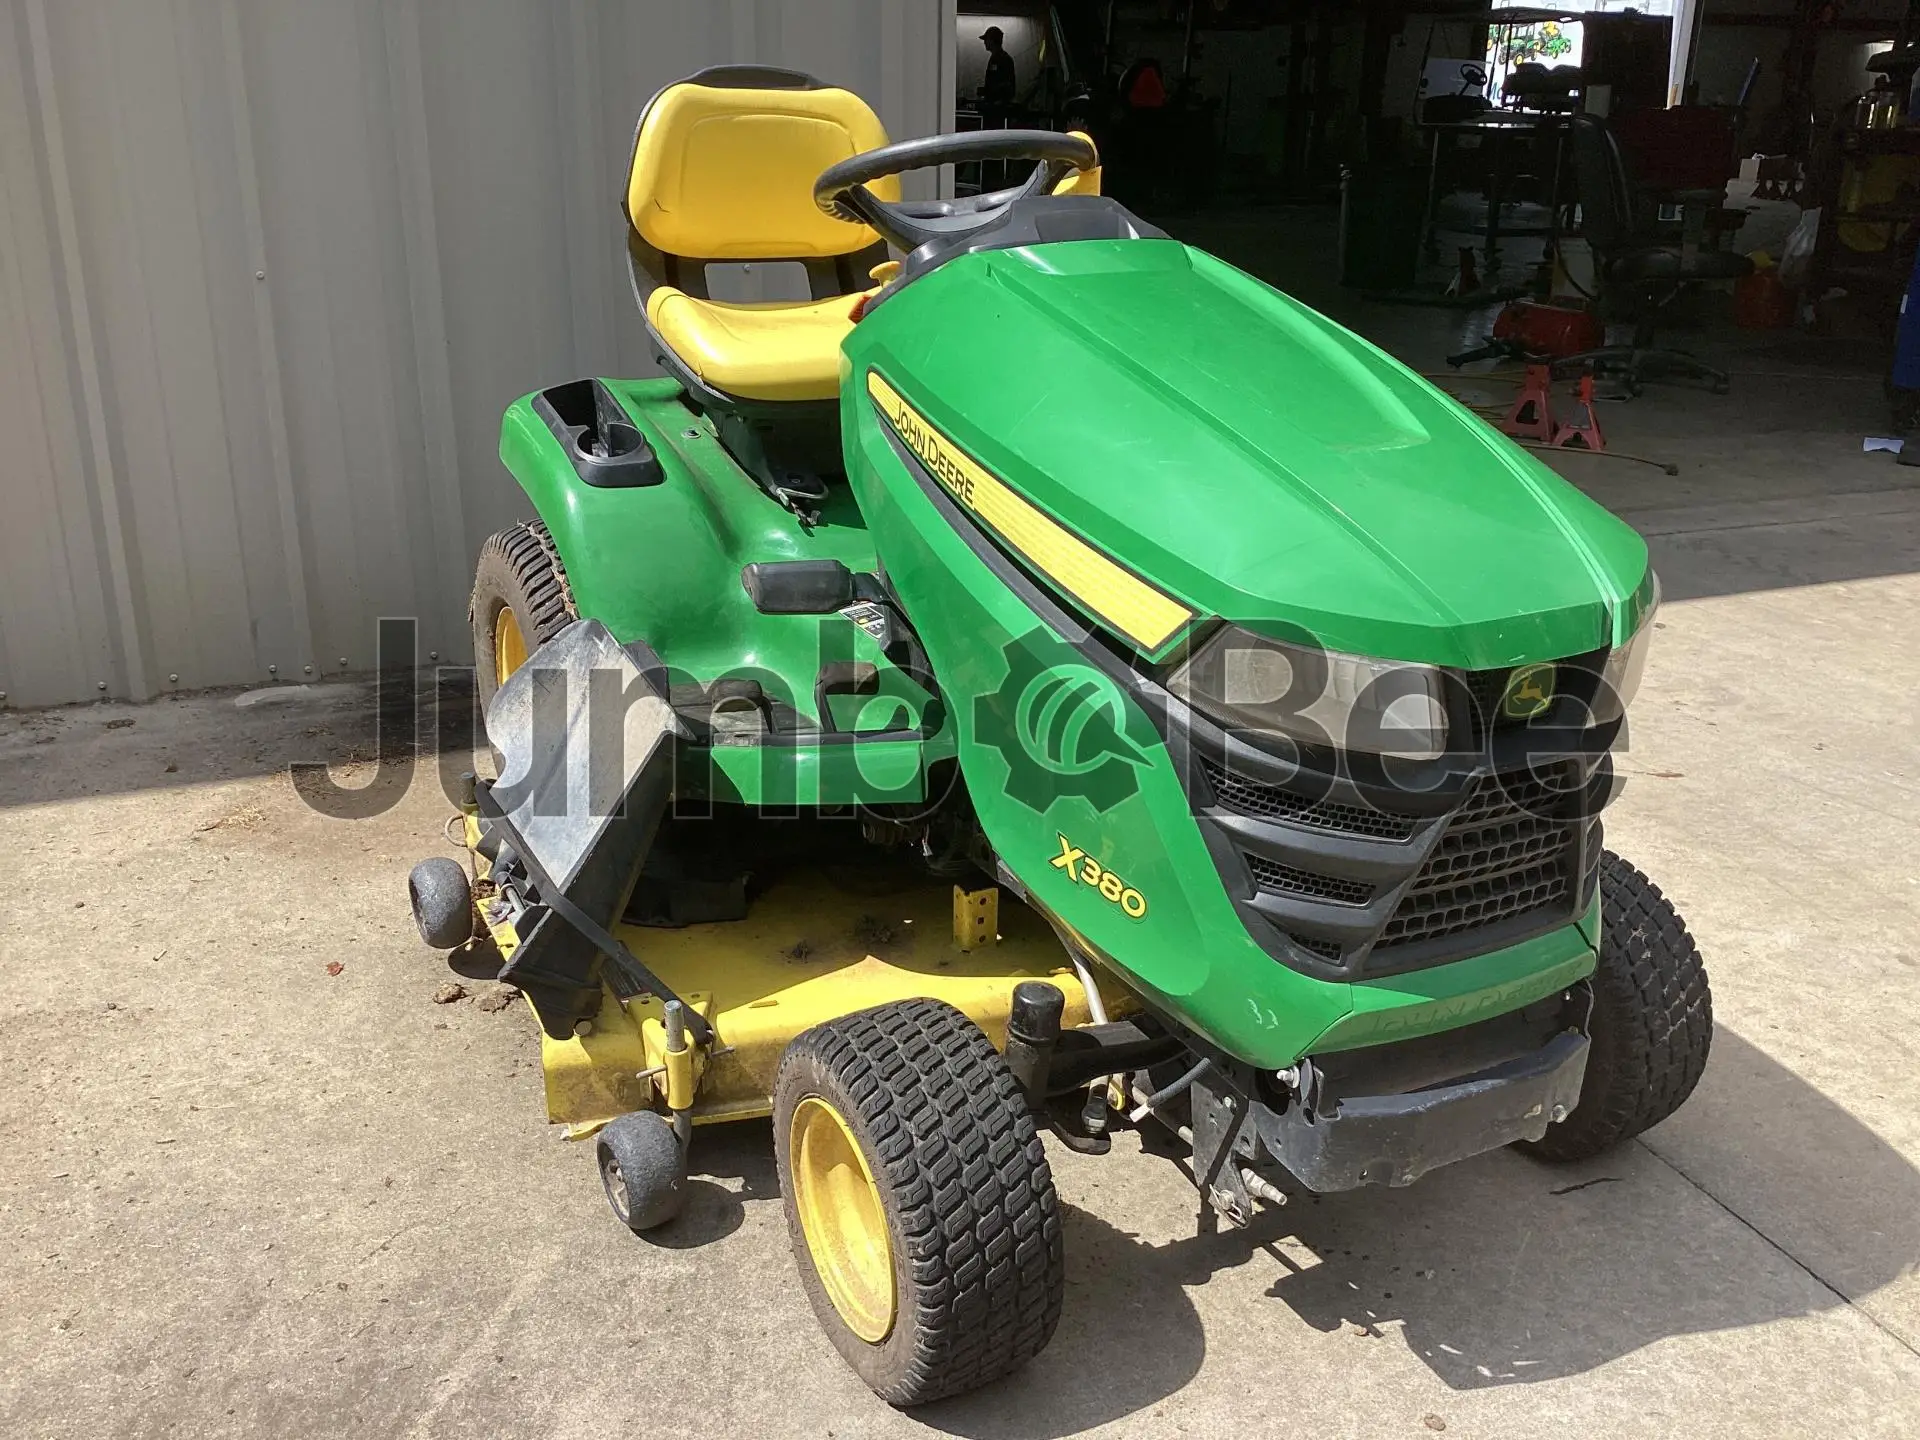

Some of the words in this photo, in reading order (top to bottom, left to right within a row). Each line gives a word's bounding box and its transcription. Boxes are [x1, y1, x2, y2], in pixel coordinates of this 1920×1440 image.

[894, 401, 926, 456] JOHN
[927, 434, 975, 505] DEERE
[1048, 831, 1147, 919] X380
